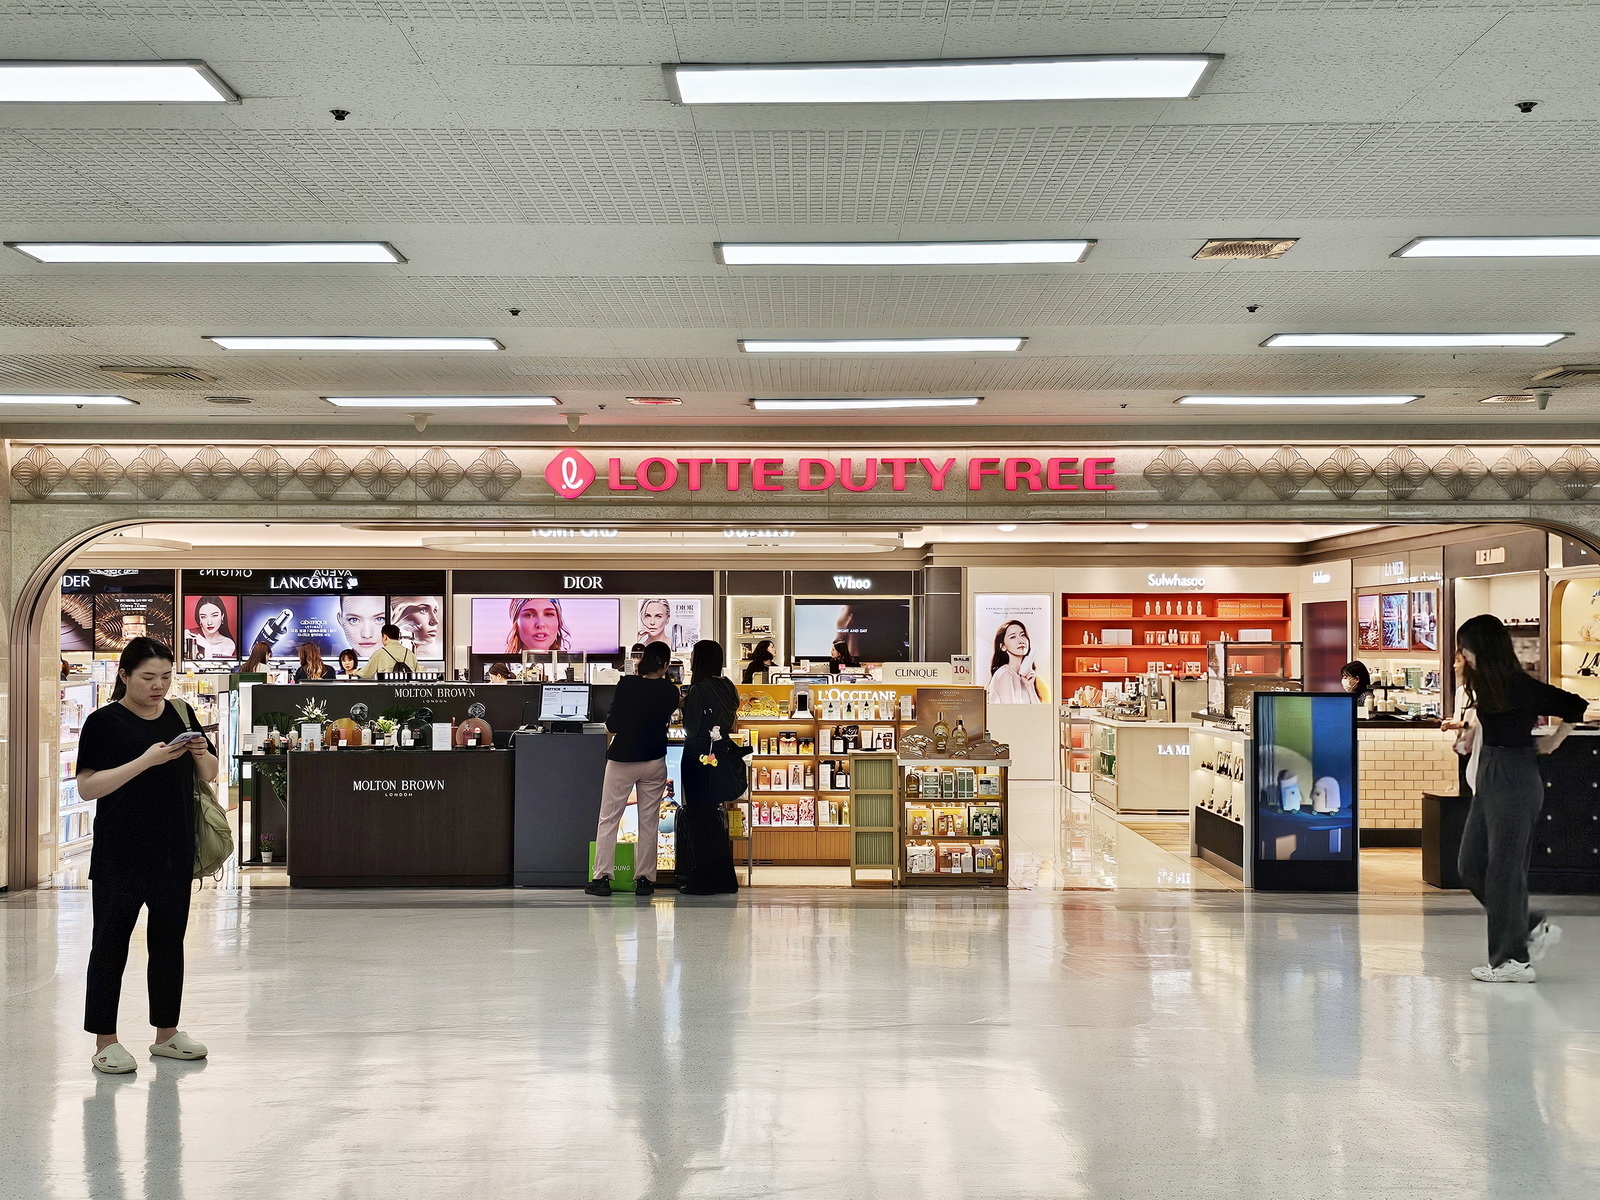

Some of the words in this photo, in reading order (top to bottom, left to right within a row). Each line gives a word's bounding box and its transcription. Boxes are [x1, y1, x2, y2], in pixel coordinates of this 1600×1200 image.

[608, 456, 784, 492] LOTTE
[798, 457, 956, 492] DUTY
[968, 457, 1117, 491] FREE
[563, 576, 604, 590] DIOR
[833, 576, 872, 590] Whoo
[1147, 572, 1206, 587] Sulwhasoo
[895, 668, 939, 679] CLINIQUE
[394, 688, 434, 698] MOLTON
[437, 688, 477, 698] BROWN
[353, 779, 398, 791] MOLTON
[401, 779, 446, 791] BROWN
